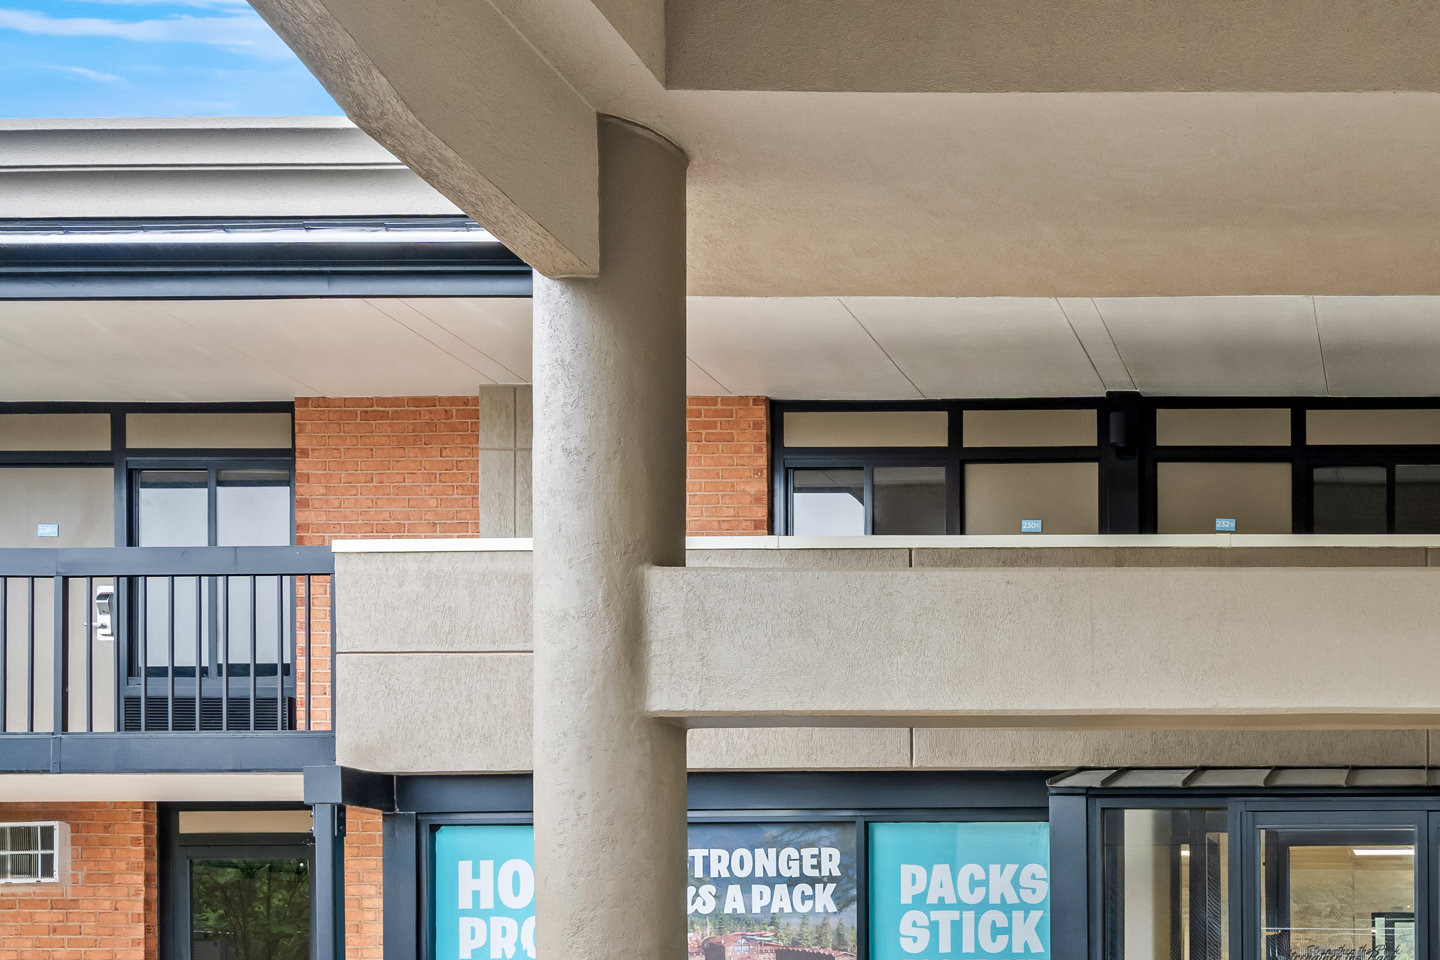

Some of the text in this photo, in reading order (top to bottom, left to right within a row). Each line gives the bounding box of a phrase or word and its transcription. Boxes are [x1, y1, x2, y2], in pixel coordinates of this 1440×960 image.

[1023, 521, 1036, 529] 230
[1216, 520, 1230, 528] 232
[687, 847, 842, 878] TRONGER
[458, 859, 535, 909] HO
[723, 884, 746, 914] A
[751, 883, 838, 913] PACK
[900, 863, 1049, 904] PACKS
[459, 916, 537, 959] PRO
[899, 910, 1045, 953] STICK
